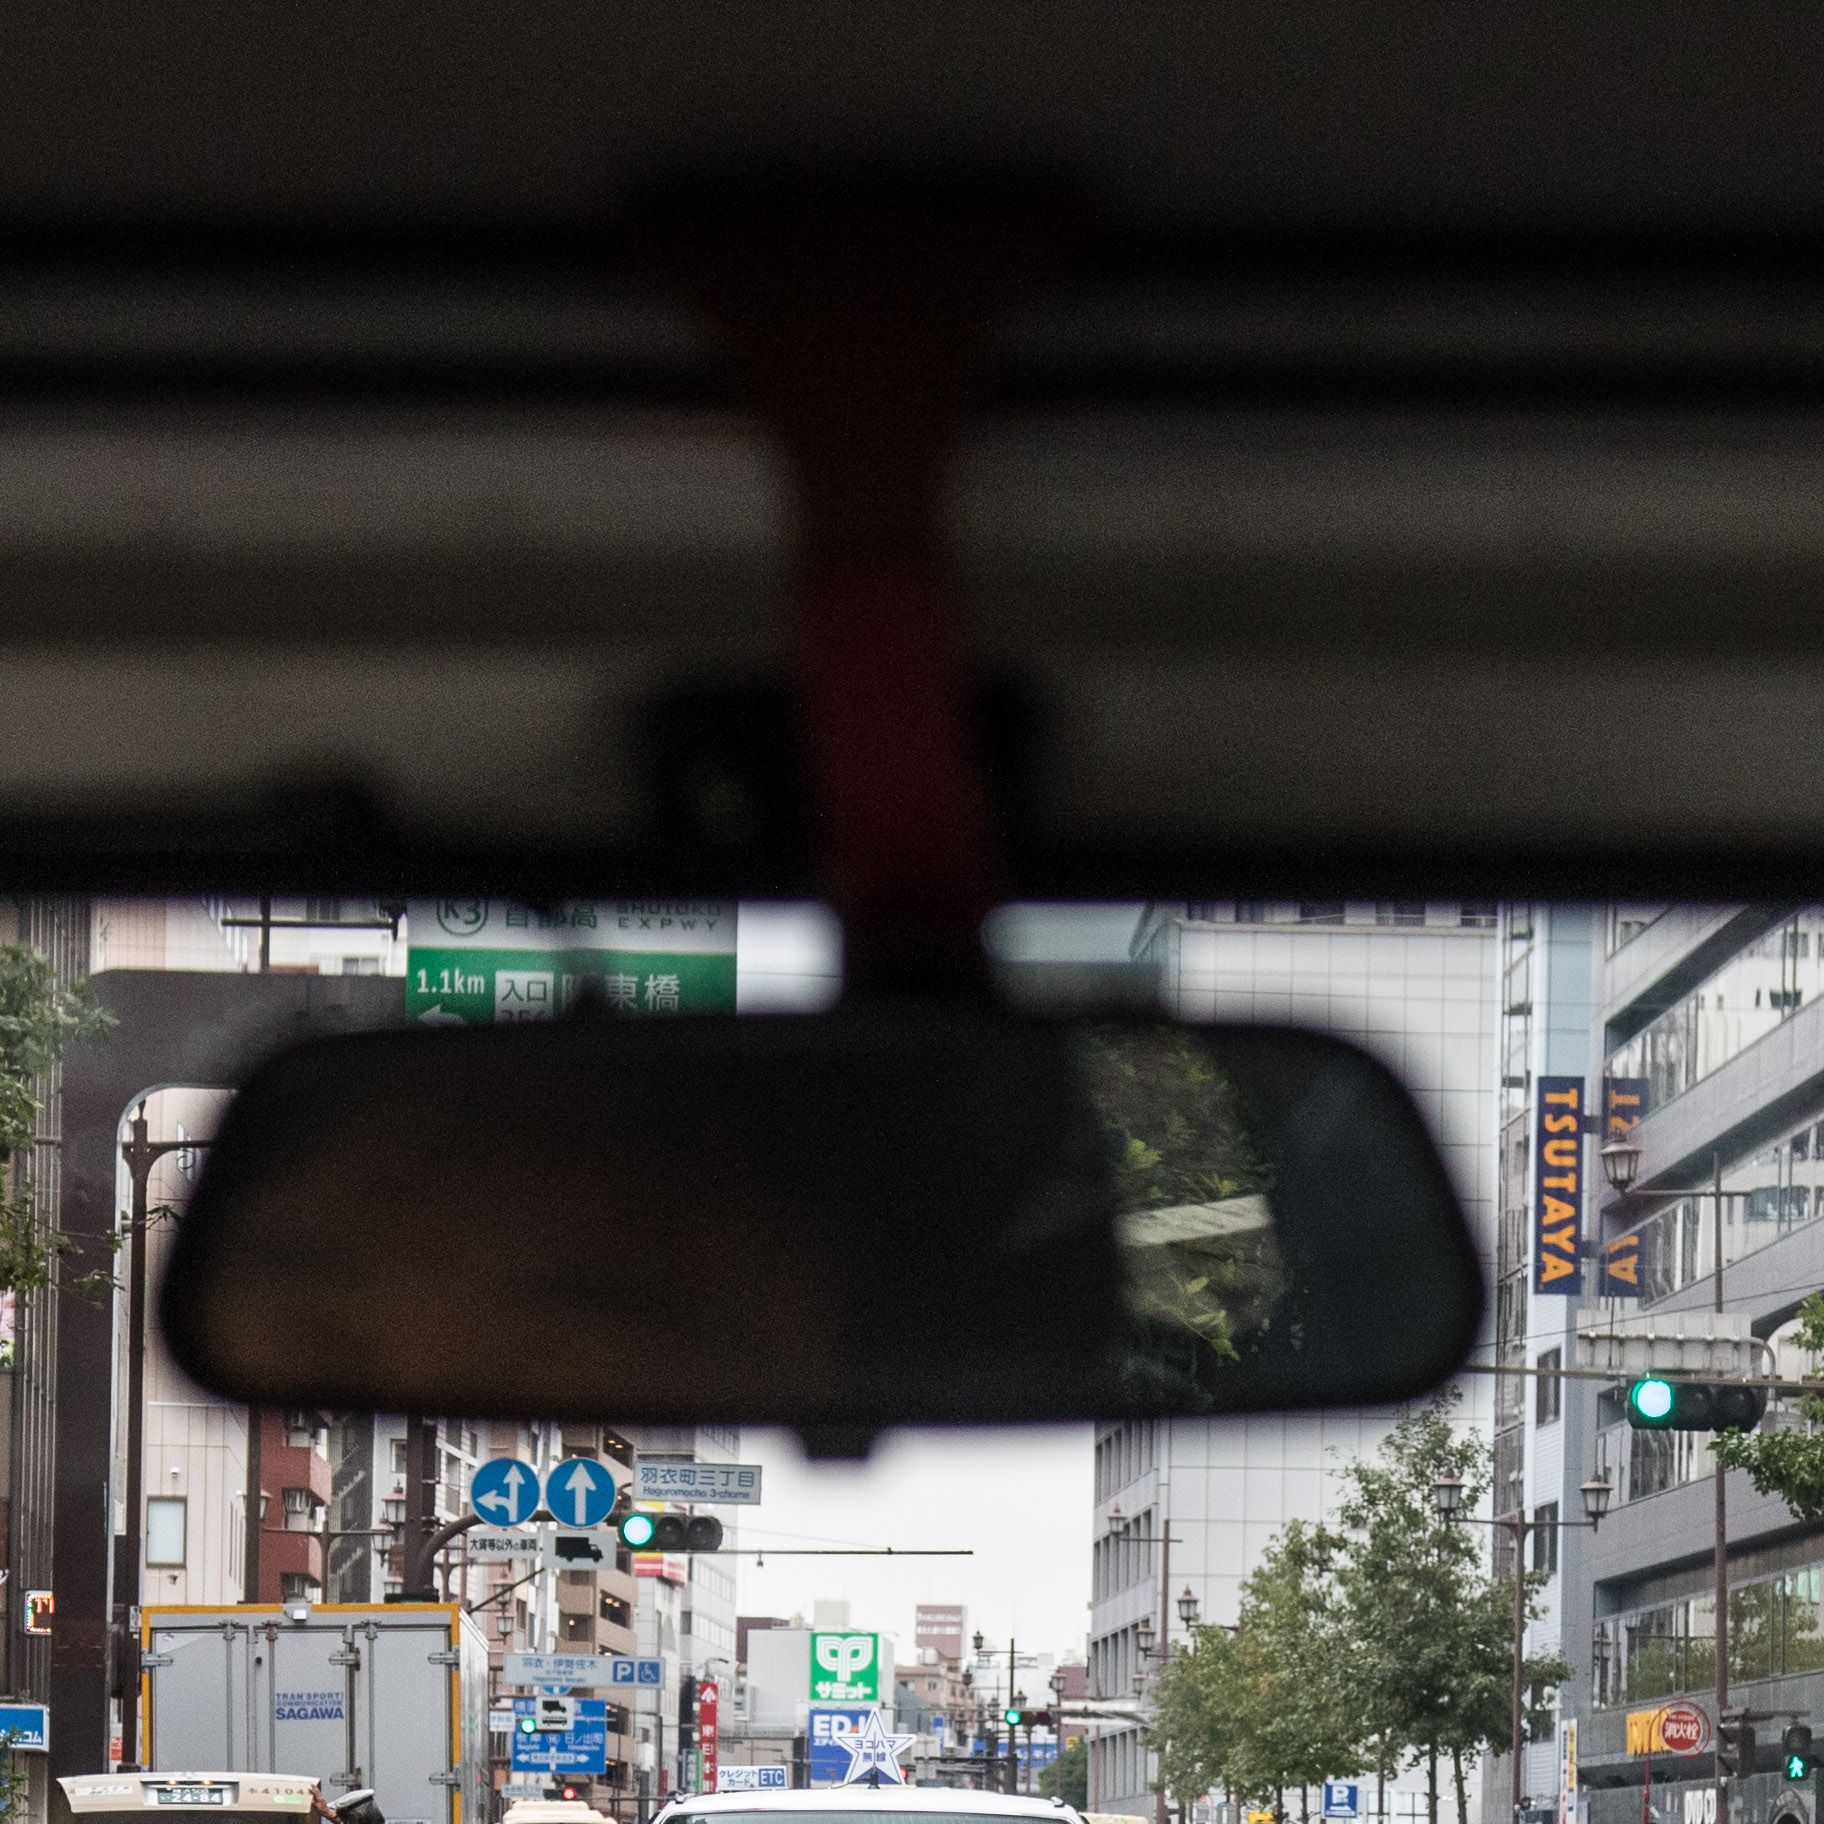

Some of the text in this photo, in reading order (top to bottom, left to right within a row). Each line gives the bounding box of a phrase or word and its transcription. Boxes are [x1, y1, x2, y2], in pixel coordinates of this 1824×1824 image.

[416, 967, 486, 996] 1.1km
[501, 979, 548, 1003] 入口
[1540, 1087, 1579, 1284] TSUTAYA
[640, 1466, 756, 1487] 羽衣町三丁目
[814, 1681, 873, 1699] サミット
[276, 1707, 344, 1720] SAGAWA
[854, 1739, 897, 1749] ヨコハマ
[863, 1752, 887, 1762] 無線
[719, 1769, 785, 1786] クレジット ETC
[727, 1778, 751, 1787] カード
[171, 1794, 221, 1803] 24-84
